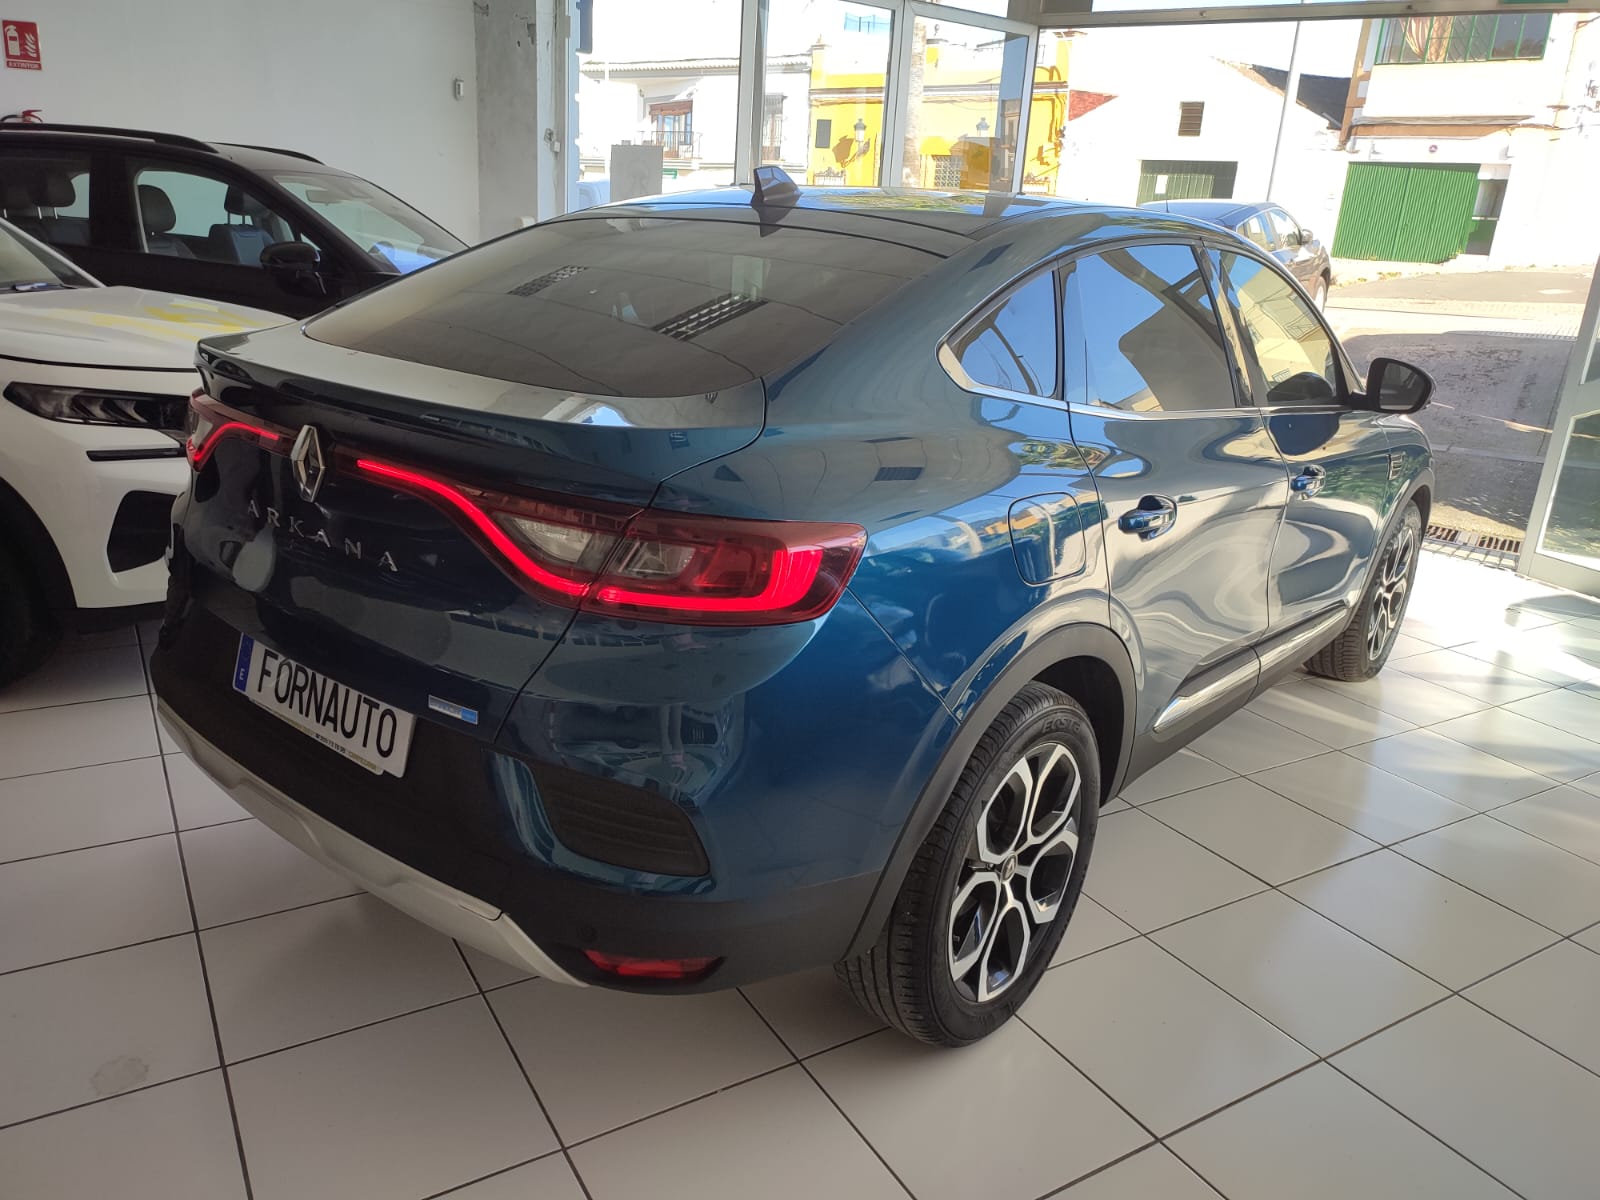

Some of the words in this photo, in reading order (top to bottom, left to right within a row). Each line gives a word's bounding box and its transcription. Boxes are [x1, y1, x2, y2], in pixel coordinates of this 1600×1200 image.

[248, 499, 398, 572] ARKANA
[239, 668, 246, 681] E
[257, 649, 397, 758] FORNAUTO
